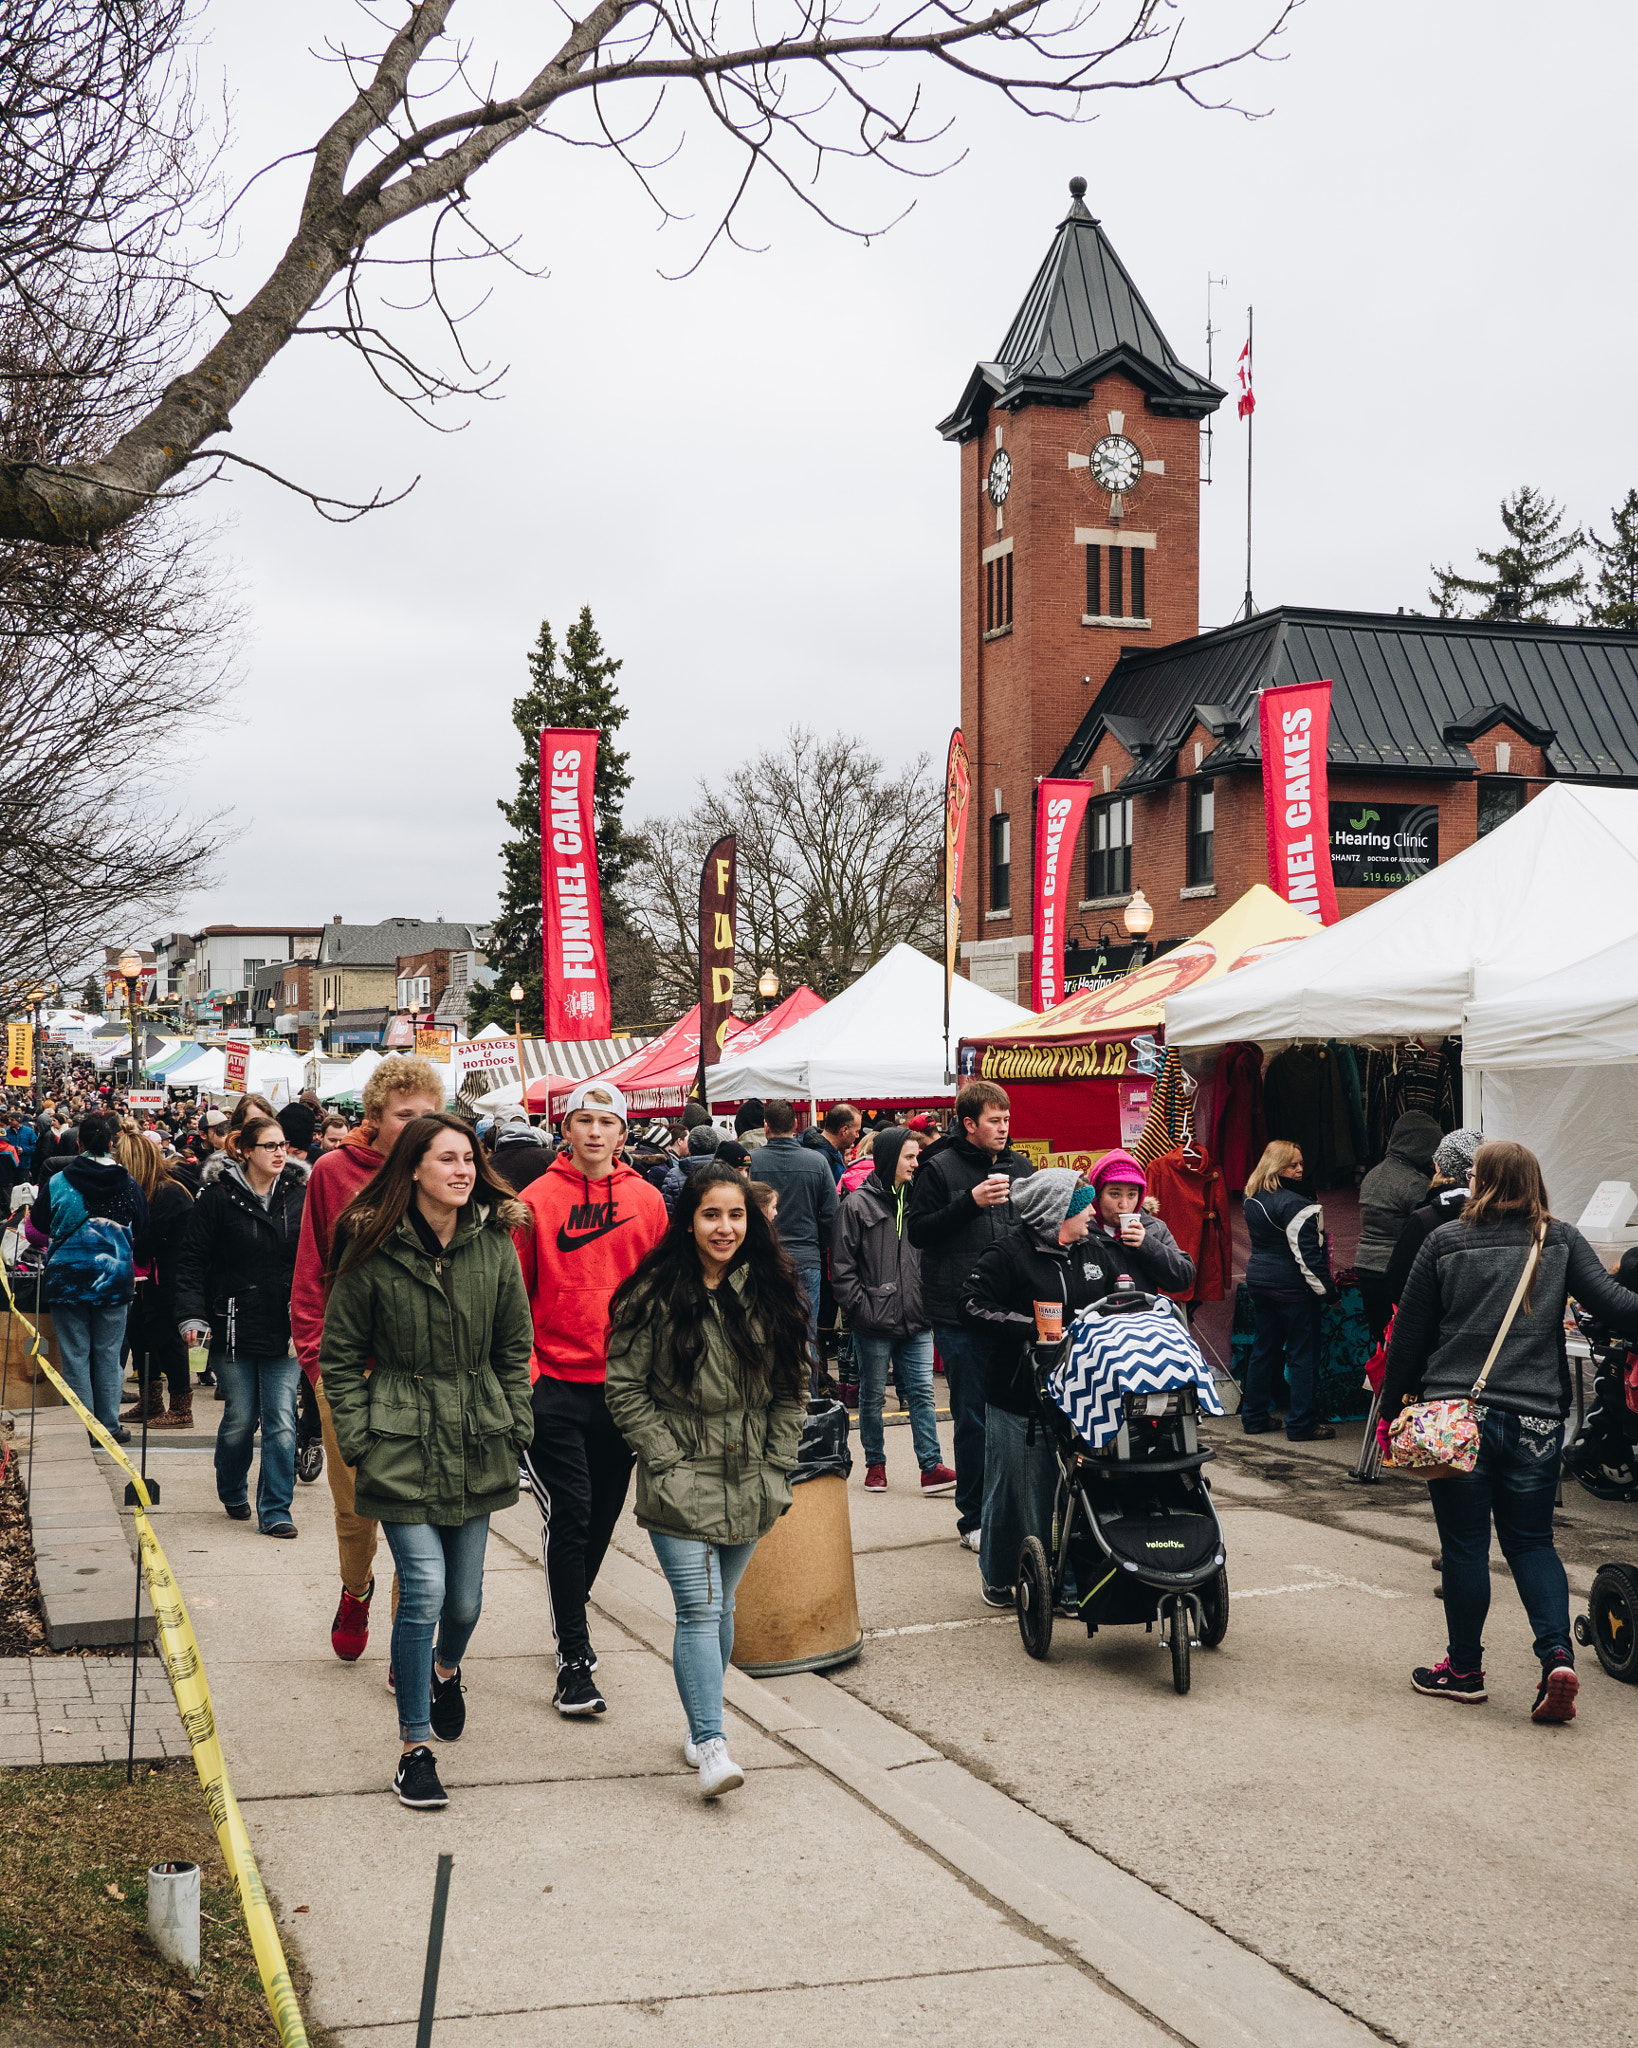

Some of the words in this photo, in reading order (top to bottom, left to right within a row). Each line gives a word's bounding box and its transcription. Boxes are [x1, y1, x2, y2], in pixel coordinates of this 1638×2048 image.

[1282, 707, 1312, 829] CAKES
[551, 749, 582, 855] CAKES
[1043, 798, 1072, 896] CAKES
[1335, 831, 1390, 849] Hearing
[1393, 833, 1428, 848] Clinic
[1331, 853, 1361, 862] SHANTZ
[1287, 834, 1322, 922] NNEL
[1363, 872, 1422, 883] 519.669.44
[556, 862, 596, 979] FUNNEL
[1041, 903, 1056, 1011] FUNNEL
[1064, 980, 1072, 992] ar
[268, 1030, 276, 1038] P
[458, 1041, 516, 1056] SAUSAGES
[228, 1055, 246, 1067] ATM
[463, 1056, 515, 1069] HOTDOGS
[981, 1040, 1128, 1079] Grainharvest.ca
[567, 1201, 620, 1230] NIKE
[1146, 1540, 1179, 1549] velocity
